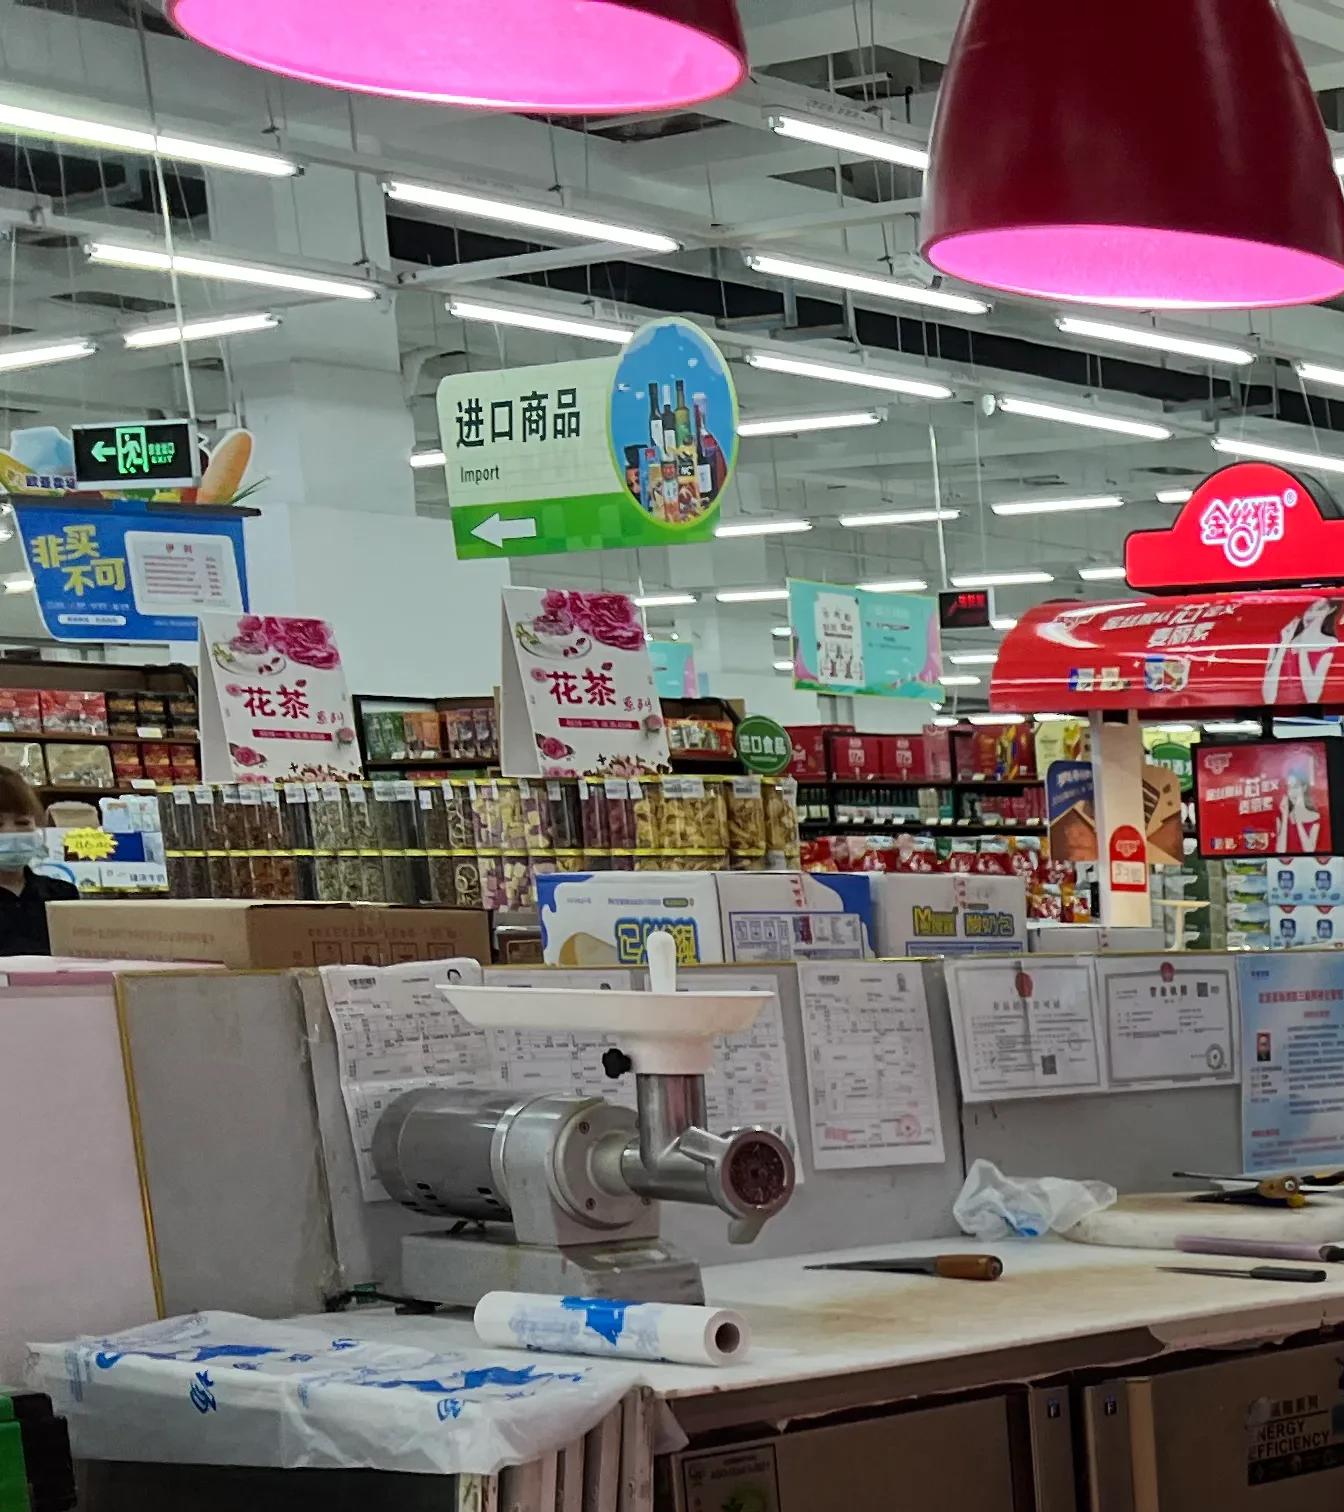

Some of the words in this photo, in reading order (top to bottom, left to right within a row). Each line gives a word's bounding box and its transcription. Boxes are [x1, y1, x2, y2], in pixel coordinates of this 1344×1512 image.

[456, 387, 581, 448] 进口商品
[151, 455, 172, 464] EXIT
[460, 464, 500, 485] Import
[1200, 496, 1284, 567] 金丝猴
[241, 682, 310, 719] 花茶
[547, 668, 617, 706] 花茶
